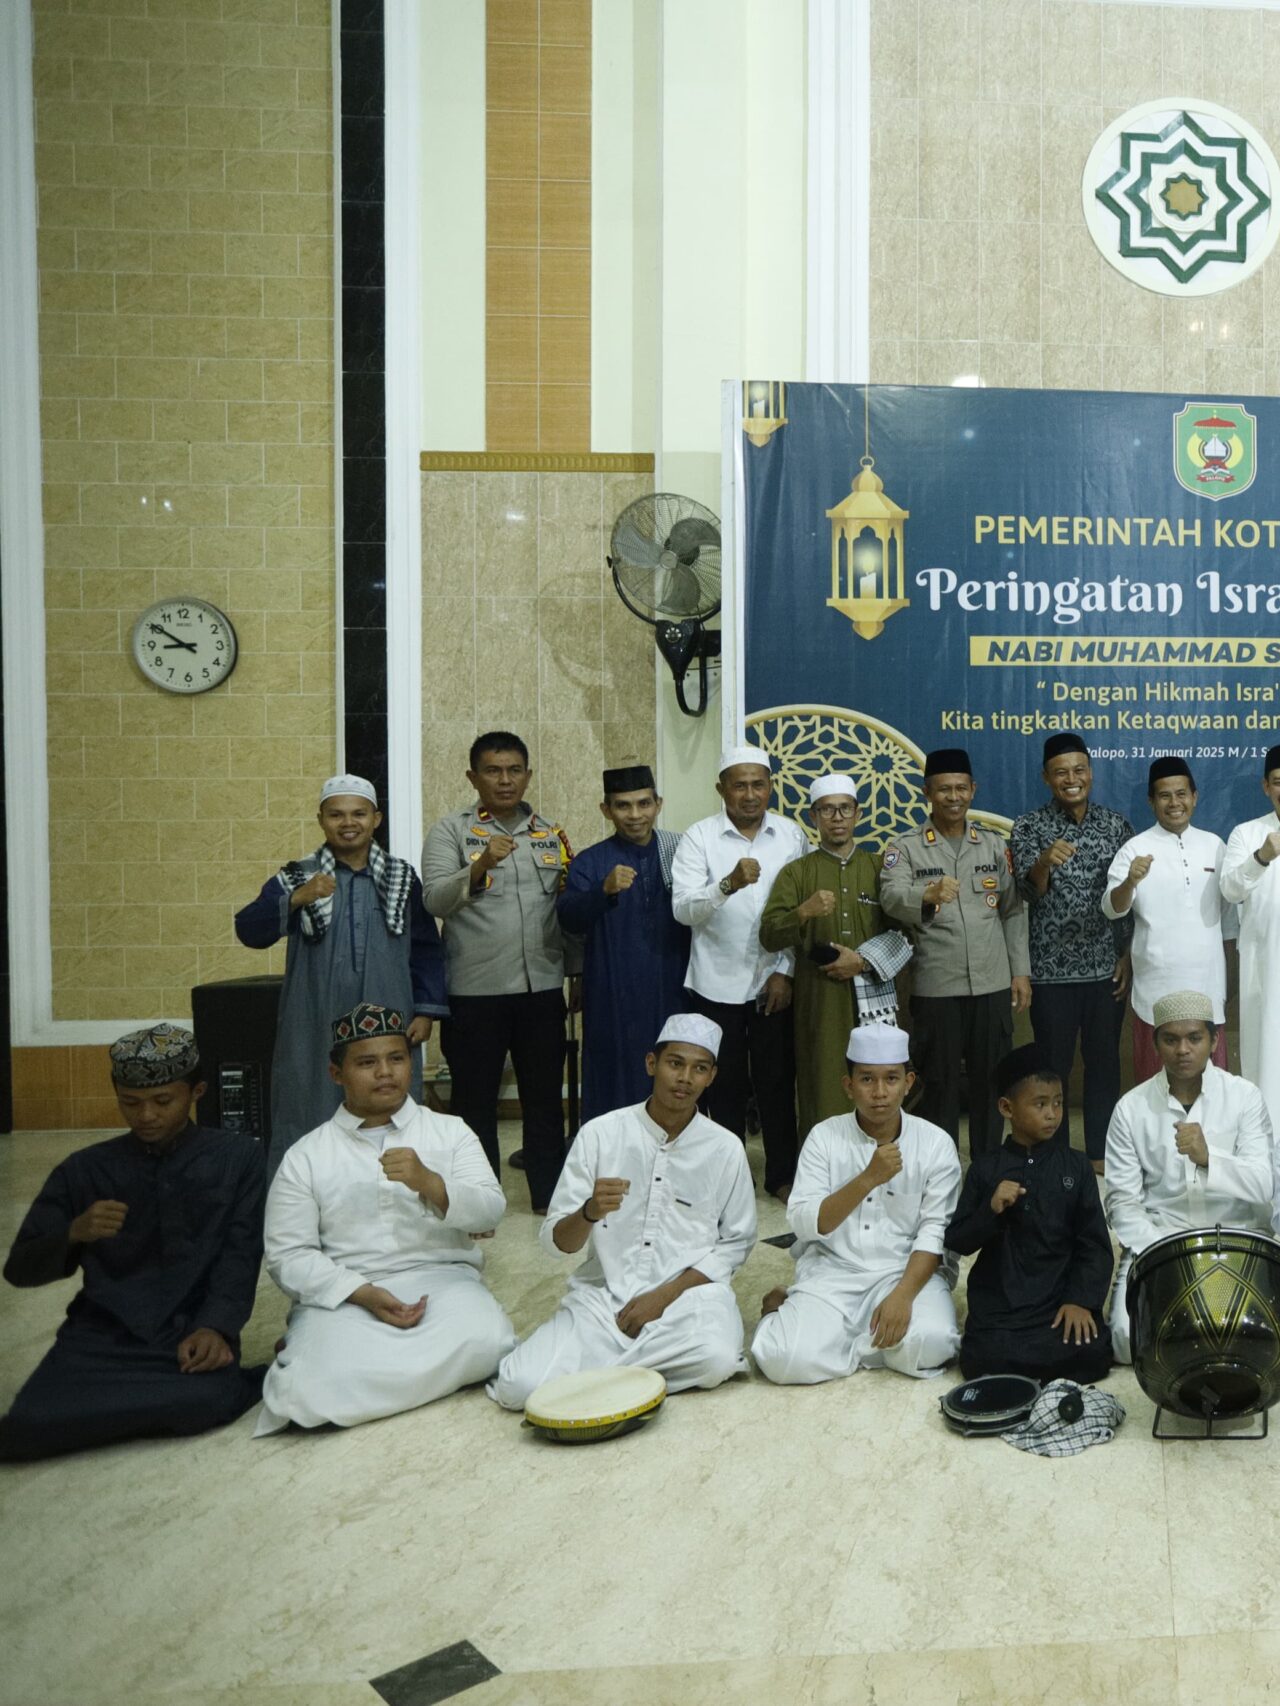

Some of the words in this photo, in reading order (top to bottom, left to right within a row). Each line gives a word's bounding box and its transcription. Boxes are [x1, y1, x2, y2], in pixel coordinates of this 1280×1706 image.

[974, 515, 1201, 547] PEMERINTAH
[915, 567, 1183, 625] Peringatan
[161, 613, 171, 623] 11
[177, 608, 190, 619] 12
[198, 613, 203, 623] 1
[210, 623, 219, 634] 2
[147, 640, 156, 651] 9
[216, 640, 224, 651] 3
[987, 641, 1064, 663] NABI
[1070, 641, 1257, 664] MUHAMMAD
[154, 656, 163, 667] 8
[212, 657, 221, 667] 4
[167, 667, 175, 678] 7
[184, 672, 193, 682] 6
[202, 667, 210, 678] 5
[1053, 682, 1138, 706] Dengan
[1145, 681, 1230, 702] Hikmah
[941, 710, 984, 731] Kita
[991, 709, 1110, 735] tingkatkan
[1117, 710, 1239, 735] Ketaqwaan
[1131, 747, 1146, 758] 31
[1148, 746, 1193, 758] Januari
[1195, 746, 1225, 758] 2025
[1228, 746, 1240, 758] M
[531, 841, 558, 849] POLRI
